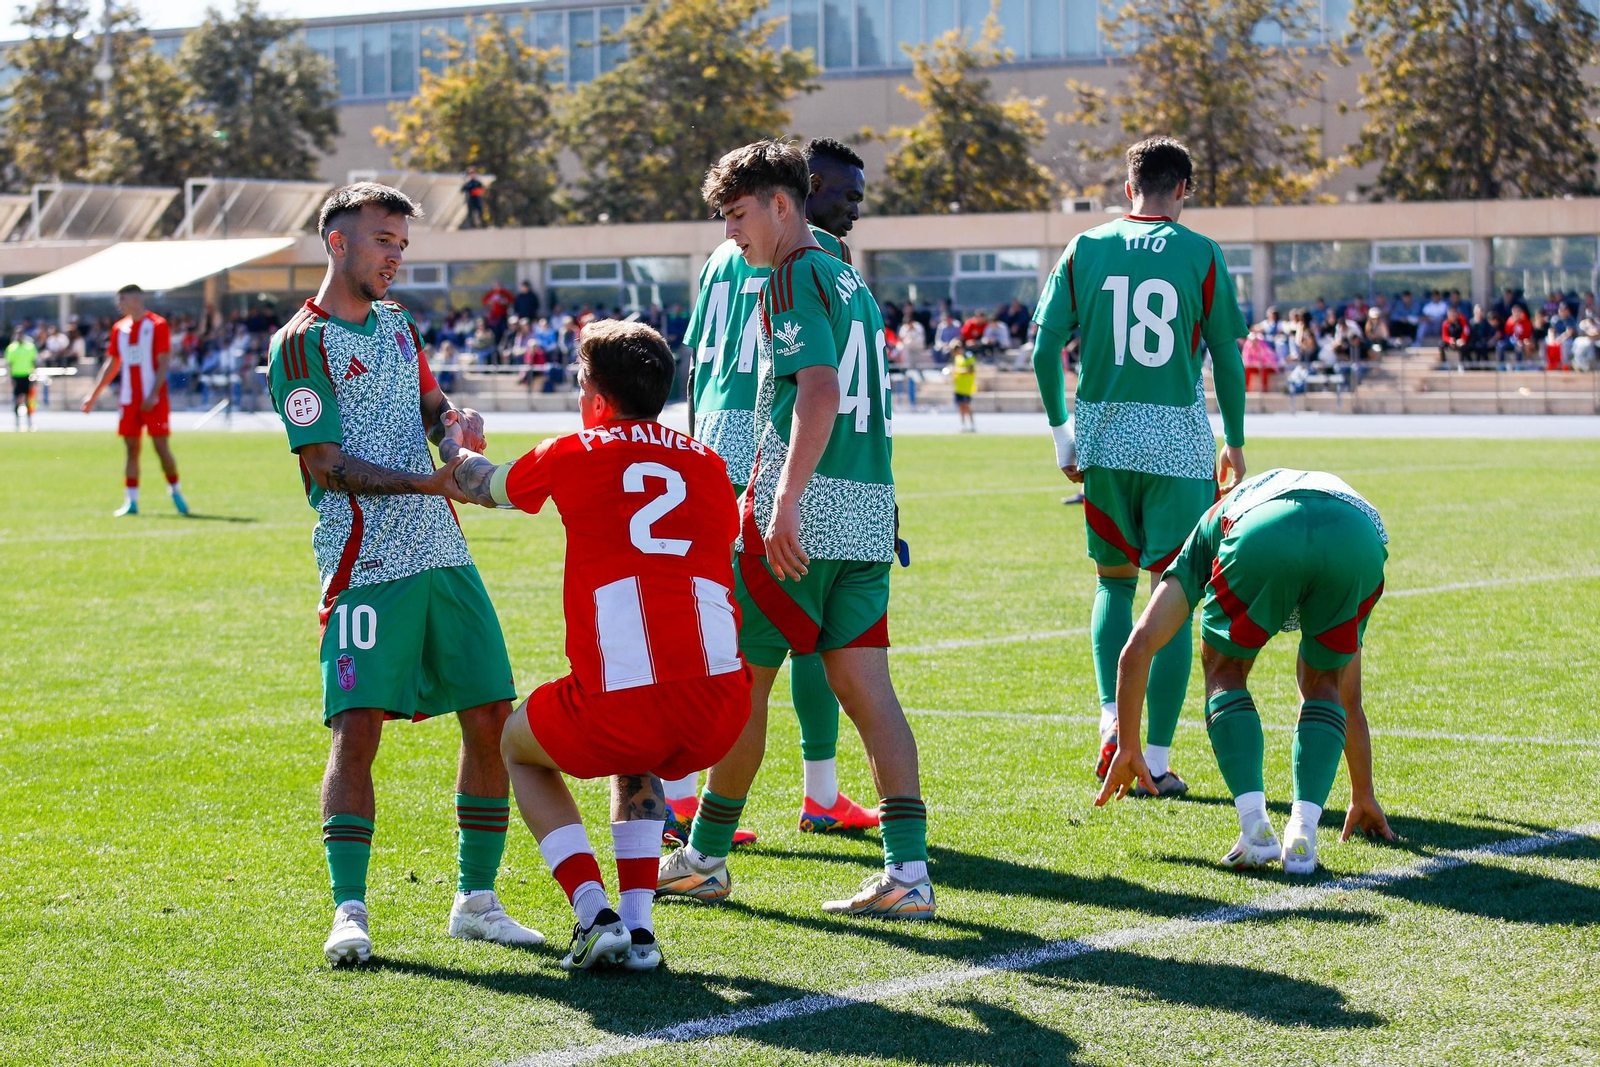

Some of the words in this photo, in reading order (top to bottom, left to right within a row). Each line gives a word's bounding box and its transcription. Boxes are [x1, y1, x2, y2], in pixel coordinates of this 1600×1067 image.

[697, 276, 768, 376] 47
[1101, 275, 1178, 367] 18
[622, 461, 693, 557] 2
[335, 604, 377, 650] 10
